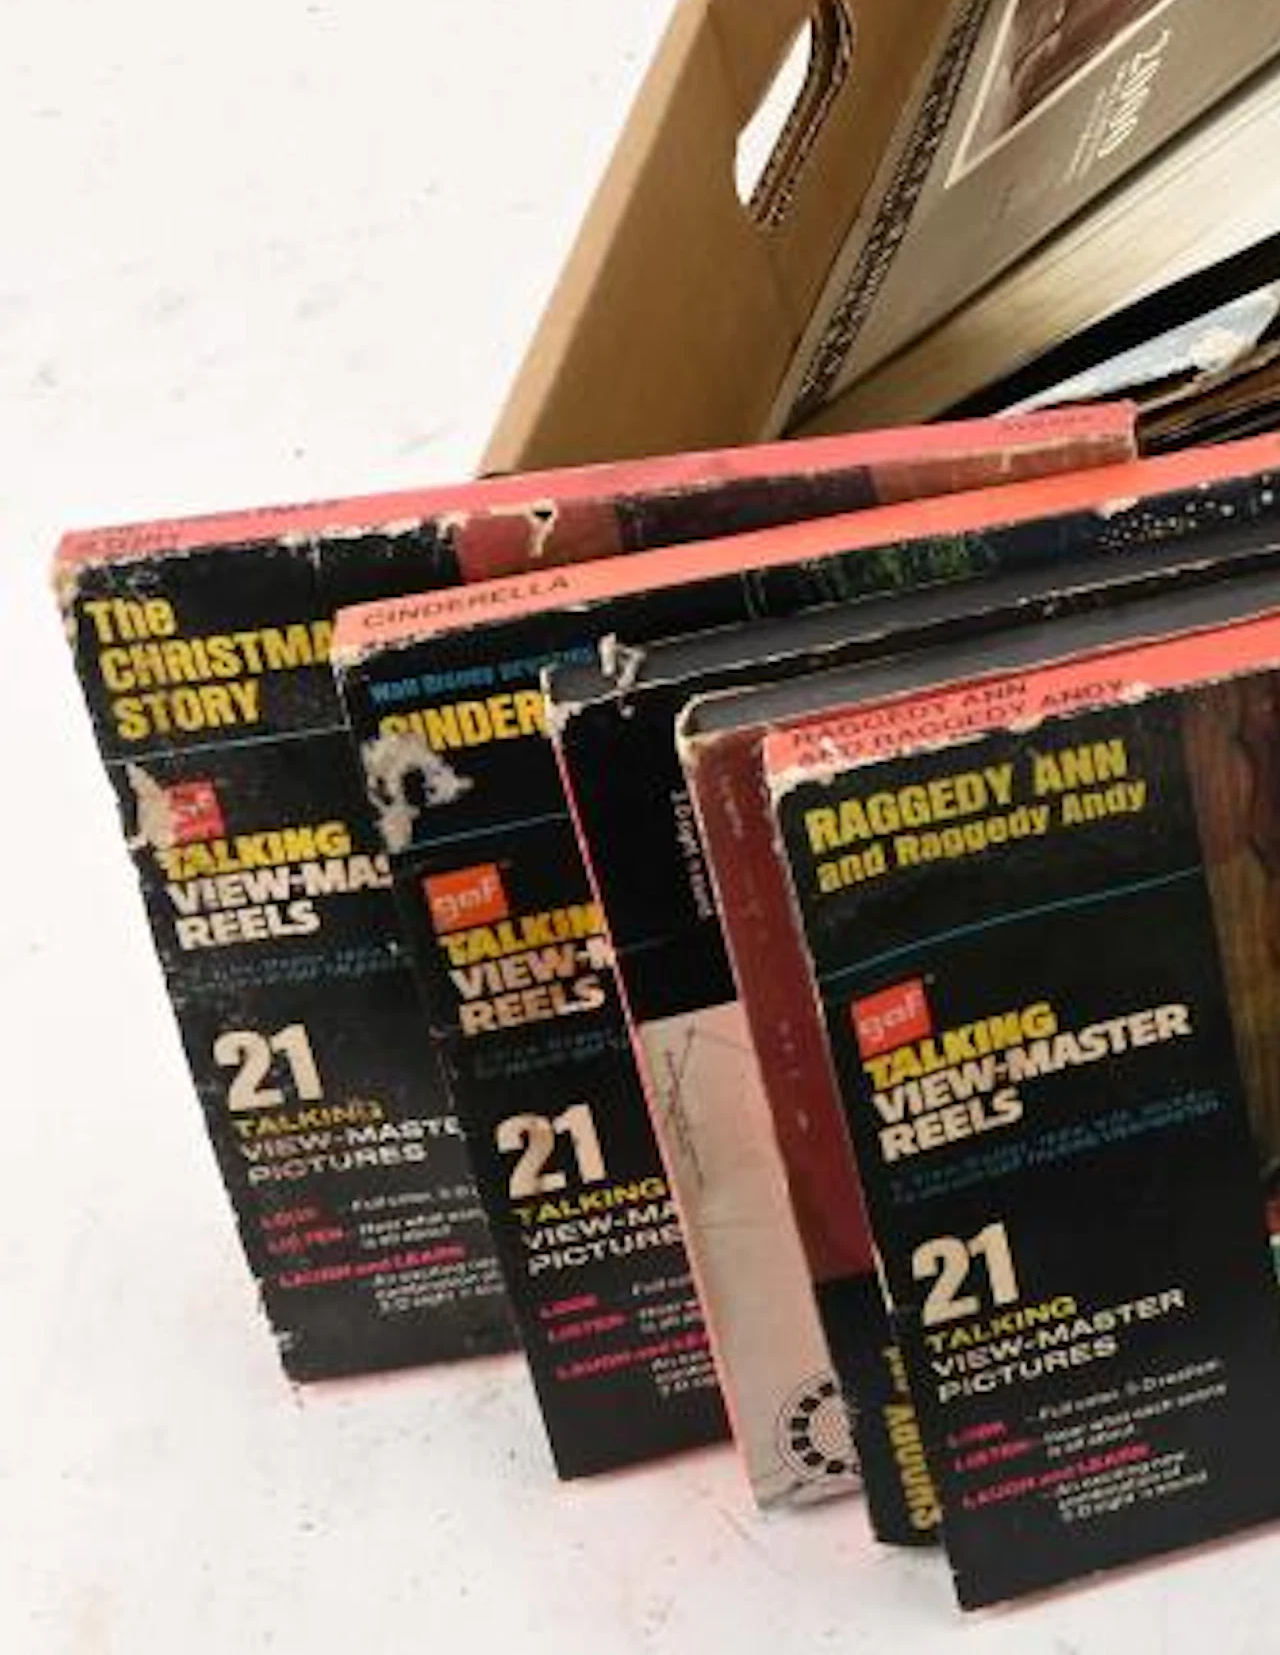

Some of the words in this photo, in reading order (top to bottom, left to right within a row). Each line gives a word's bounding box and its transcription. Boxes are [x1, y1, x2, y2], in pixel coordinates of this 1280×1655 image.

[84, 598, 176, 643] The
[363, 575, 570, 628] CINDERELLA
[100, 619, 333, 690] CHRISTMA
[112, 679, 260, 740] STORY
[379, 689, 549, 751] CINDER
[875, 701, 1027, 747] RAGGEDY
[962, 681, 1027, 707] ANN
[805, 763, 1013, 853] RAGGEDY
[1032, 739, 1129, 795] ANN
[155, 820, 350, 881] TALKING
[817, 844, 887, 893] and
[895, 804, 1051, 866] Raggedy
[1062, 780, 1148, 825] Andy
[167, 855, 393, 914] VIEW-MA
[176, 901, 321, 951] REELS
[439, 902, 607, 967] TALKIN
[460, 977, 605, 1036] REELS
[213, 1023, 324, 1111] 21
[863, 1001, 1058, 1091] TALKING
[872, 1004, 1193, 1124] VIEW-MASTER
[233, 1100, 383, 1139] TALKING
[242, 1115, 463, 1162] VIEW-MASTE
[879, 1087, 1023, 1162] REELS
[249, 1144, 428, 1185] PICTURES
[497, 1103, 606, 1199] 21
[512, 1176, 668, 1226] TALKING
[522, 1200, 679, 1250] VIEW-MA
[527, 1226, 685, 1276] PICTURE
[912, 1221, 1021, 1326] 21
[925, 1295, 1077, 1354] TALKING
[930, 1289, 1186, 1378] VIEW-MASTER
[938, 1336, 1118, 1402] PICTURES
